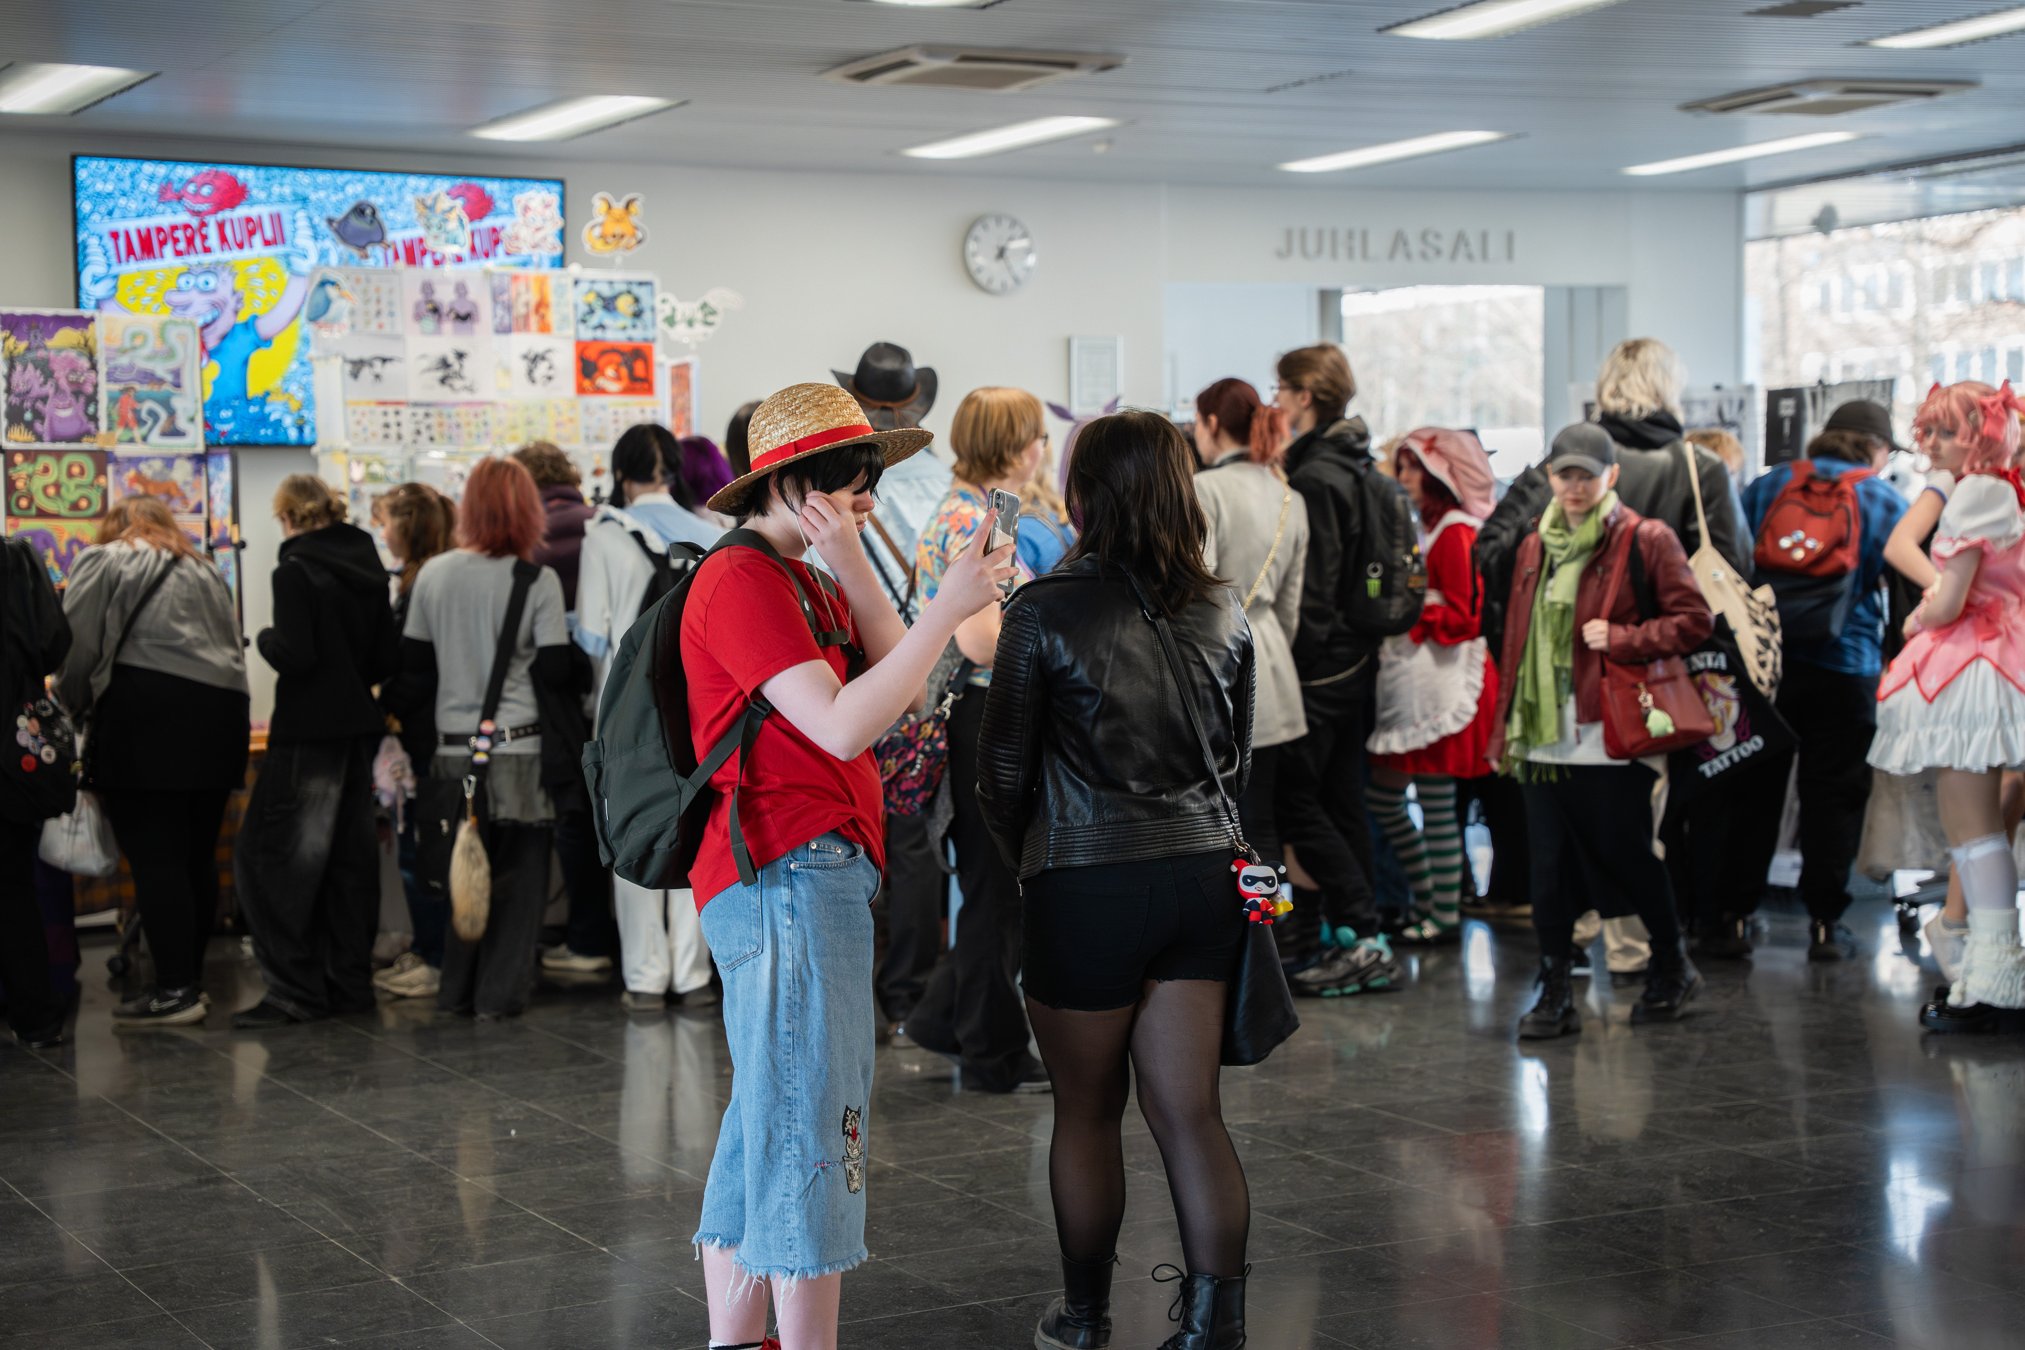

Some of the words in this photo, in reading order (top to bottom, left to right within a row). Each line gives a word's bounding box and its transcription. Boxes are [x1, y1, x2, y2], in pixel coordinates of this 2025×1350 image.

[109, 220, 212, 264] TAMPERE
[216, 212, 286, 252] KUPLII
[1276, 227, 1515, 262] JUHLASALI
[1698, 734, 1765, 779] TATTOO
